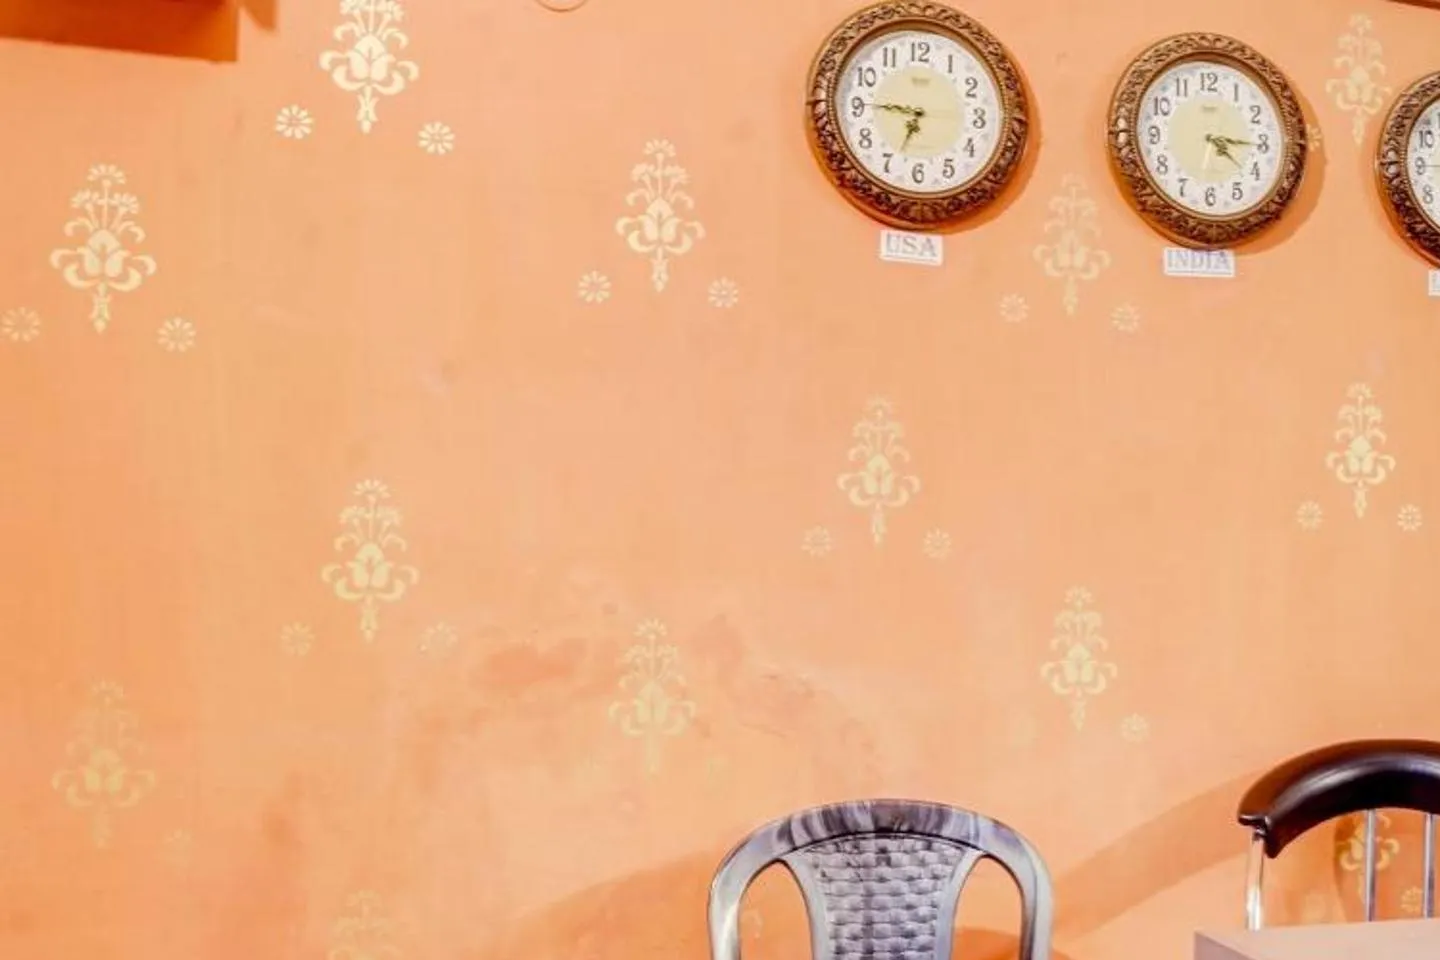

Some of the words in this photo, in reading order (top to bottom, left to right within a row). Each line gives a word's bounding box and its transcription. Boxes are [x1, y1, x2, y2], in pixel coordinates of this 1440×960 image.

[883, 47, 896, 69] 11
[910, 42, 930, 63] 12
[947, 54, 953, 74] 1
[857, 66, 877, 88] 10
[965, 77, 978, 98] 2
[1176, 77, 1189, 98] 11
[1200, 72, 1218, 93] 12
[1233, 83, 1239, 102] 1
[852, 97, 865, 118] 9
[1153, 96, 1171, 117] 10
[1250, 104, 1262, 125] 2
[972, 108, 987, 129] 3
[858, 128, 873, 149] 8
[1148, 125, 1161, 145] 9
[1256, 133, 1270, 154] 3
[1418, 130, 1434, 149] 10
[963, 137, 975, 158] 4
[882, 153, 893, 174] 7
[912, 163, 925, 184] 6
[942, 158, 956, 179] 5
[1156, 155, 1169, 175] 8
[1250, 161, 1261, 181] 4
[1416, 157, 1426, 176] 9
[1177, 178, 1189, 198] 7
[1204, 186, 1217, 207] 6
[1231, 182, 1244, 201] 5
[1422, 184, 1434, 204] 8
[886, 232, 938, 257] USA
[1167, 249, 1232, 270] INDIA
